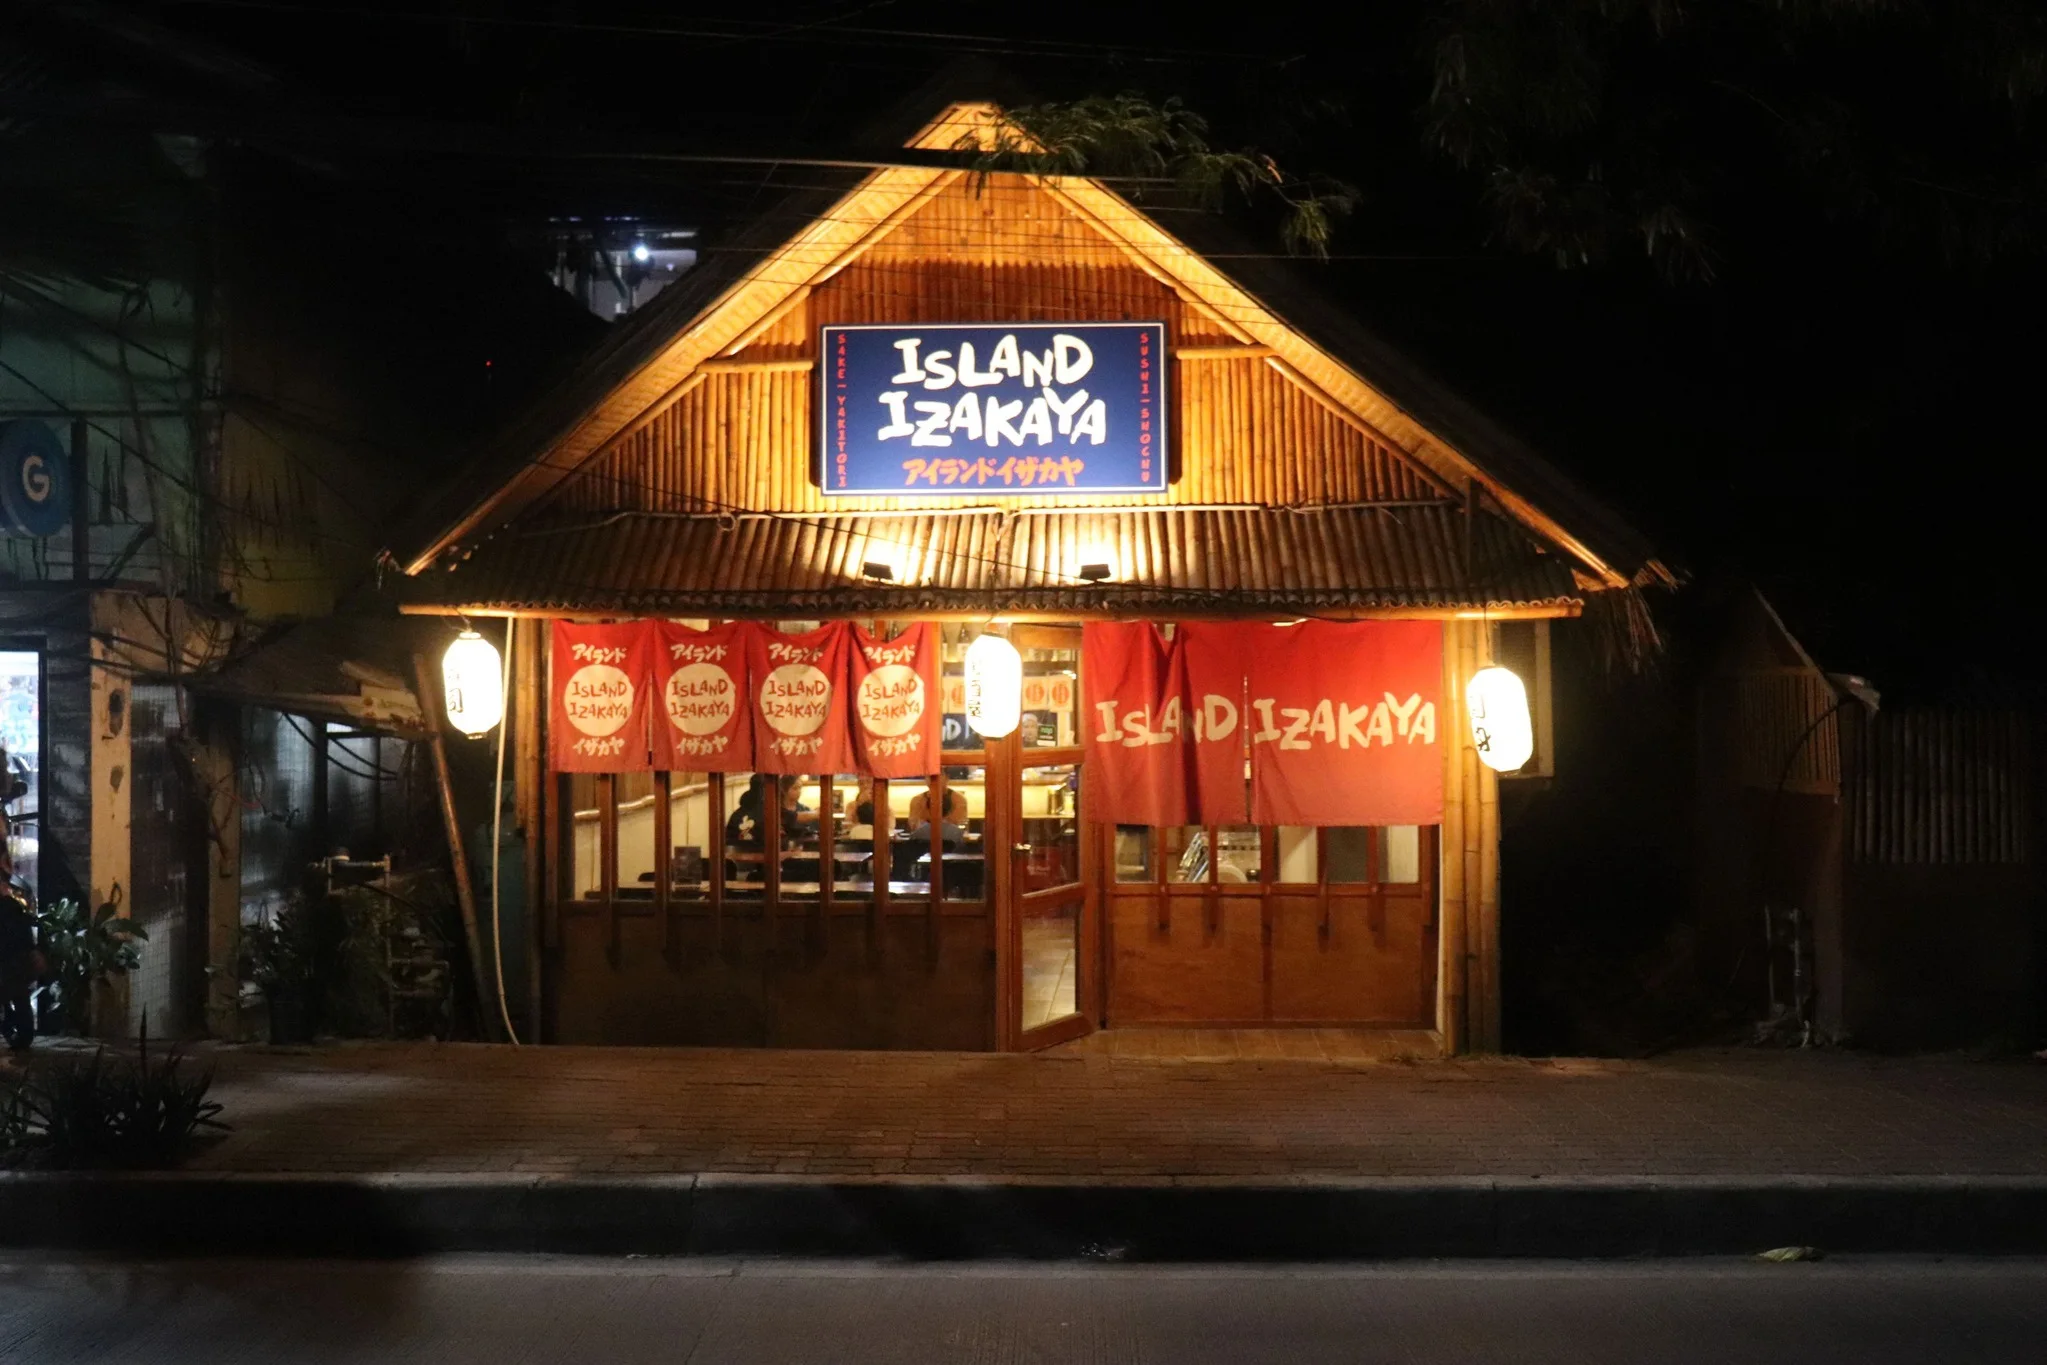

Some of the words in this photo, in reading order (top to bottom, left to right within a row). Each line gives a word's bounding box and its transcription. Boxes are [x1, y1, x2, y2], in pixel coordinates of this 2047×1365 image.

[891, 333, 1094, 390] ISLAND
[877, 387, 1106, 447] IZAKAYA
[22, 455, 50, 502] G
[572, 681, 628, 698] ISLAND
[671, 679, 729, 697] ISLAND
[768, 680, 826, 697] ISLAND
[865, 678, 917, 700] ISLAND
[569, 702, 628, 719] IZAKAYA
[670, 701, 730, 719] IZAKAYA
[765, 701, 826, 718] IZAKAYA
[862, 700, 920, 721] IZAKAYA
[1095, 694, 1239, 748] ISLAND
[1254, 691, 1436, 750] IZAKAYA
